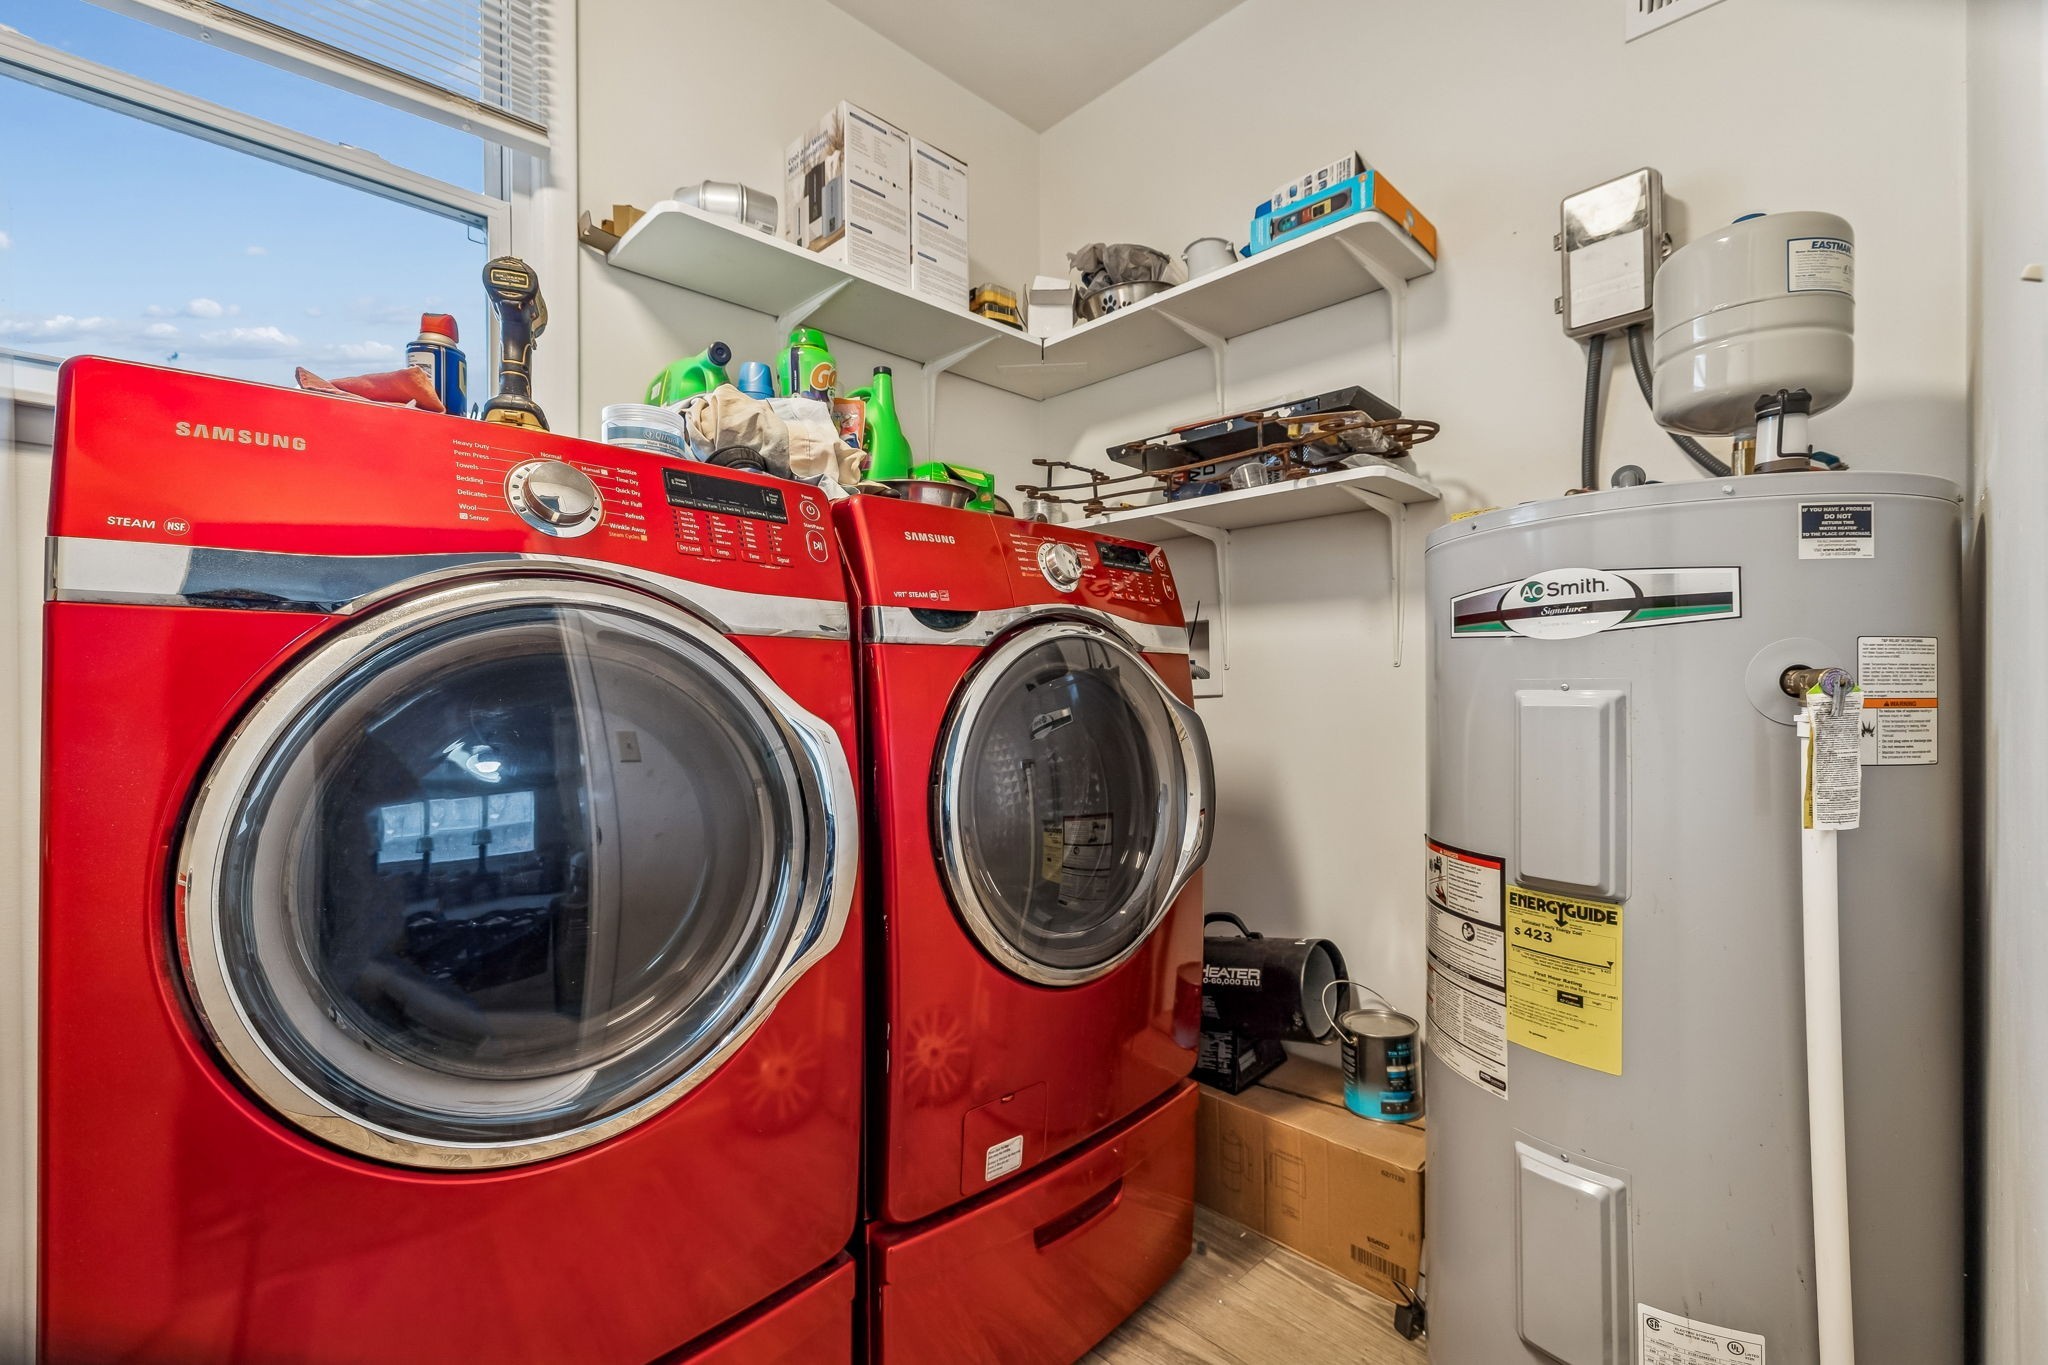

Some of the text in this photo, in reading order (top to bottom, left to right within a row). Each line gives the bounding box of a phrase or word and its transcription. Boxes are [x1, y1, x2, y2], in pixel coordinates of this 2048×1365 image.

[1812, 240, 1852, 254] EASTMAN
[175, 421, 307, 450] SAMSUNG
[452, 440, 472, 448] Heavy
[540, 452, 562, 460] Normal
[456, 462, 479, 470] Towels
[456, 474, 484, 484] Bedding
[457, 489, 488, 498] Delicates
[106, 516, 156, 528] STEAM
[904, 531, 956, 545] SAMSUNG
[1541, 606, 1587, 616] Signature
[1509, 892, 1618, 926] ENERGYGUIDE
[1521, 919, 1543, 927] Estimated
[1556, 926, 1571, 935] Energy
[1514, 926, 1552, 943] $ 423
[1563, 978, 1583, 987] Rating
[1731, 1344, 1740, 1353] UL
